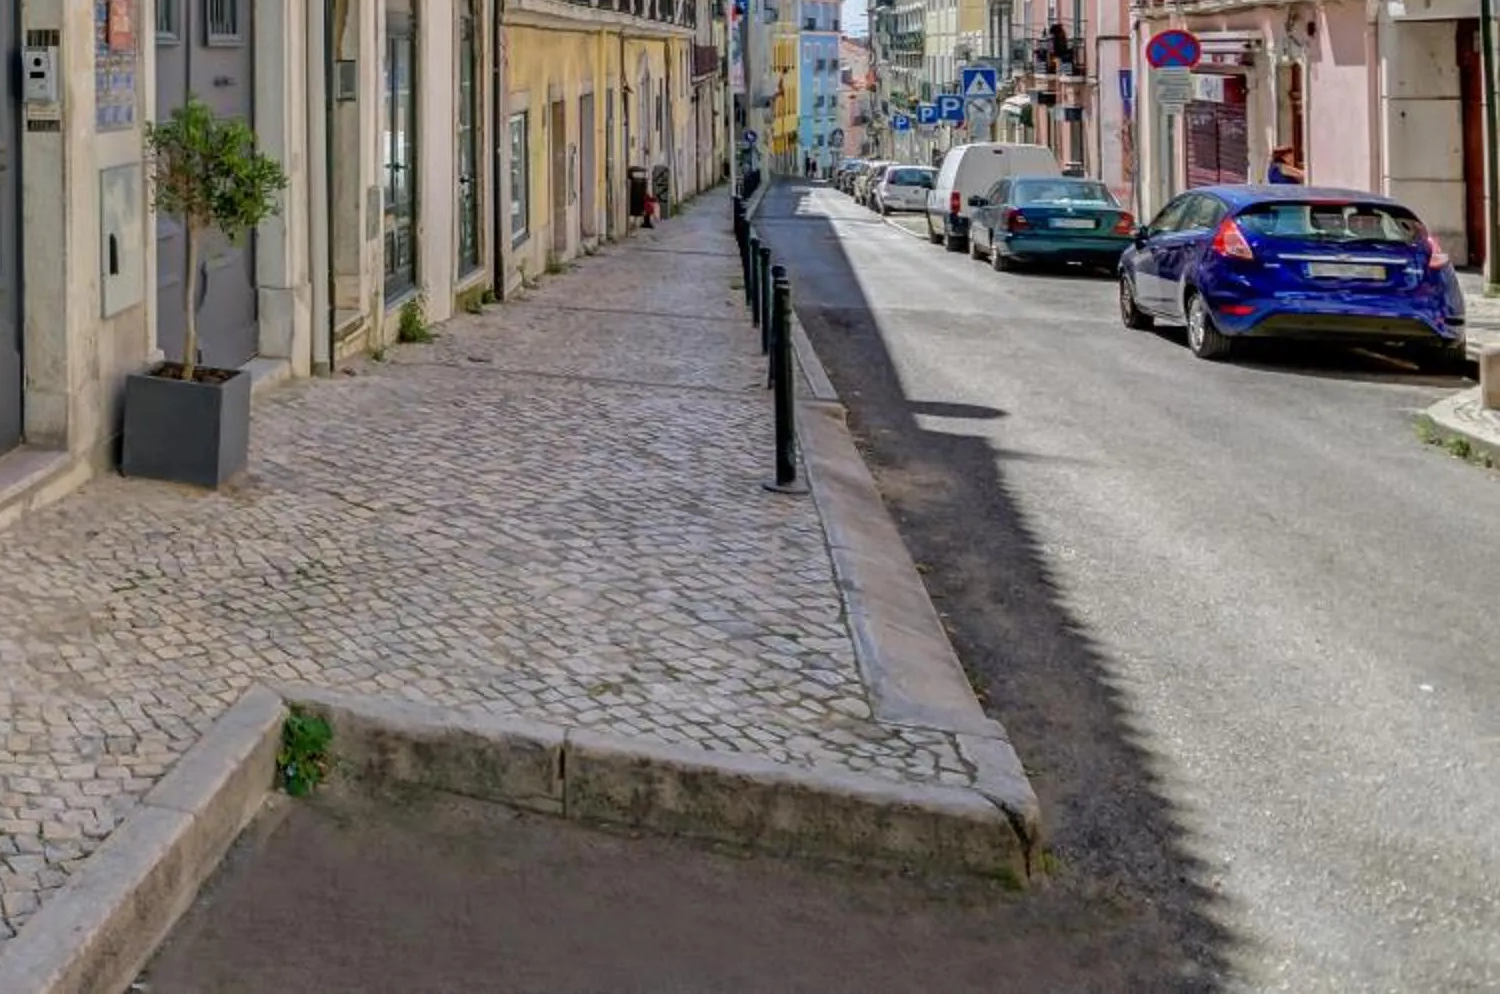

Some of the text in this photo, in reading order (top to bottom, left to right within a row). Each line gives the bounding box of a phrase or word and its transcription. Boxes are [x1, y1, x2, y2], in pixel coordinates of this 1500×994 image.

[922, 108, 934, 122] P
[942, 98, 960, 118] P
[896, 117, 907, 128] P
